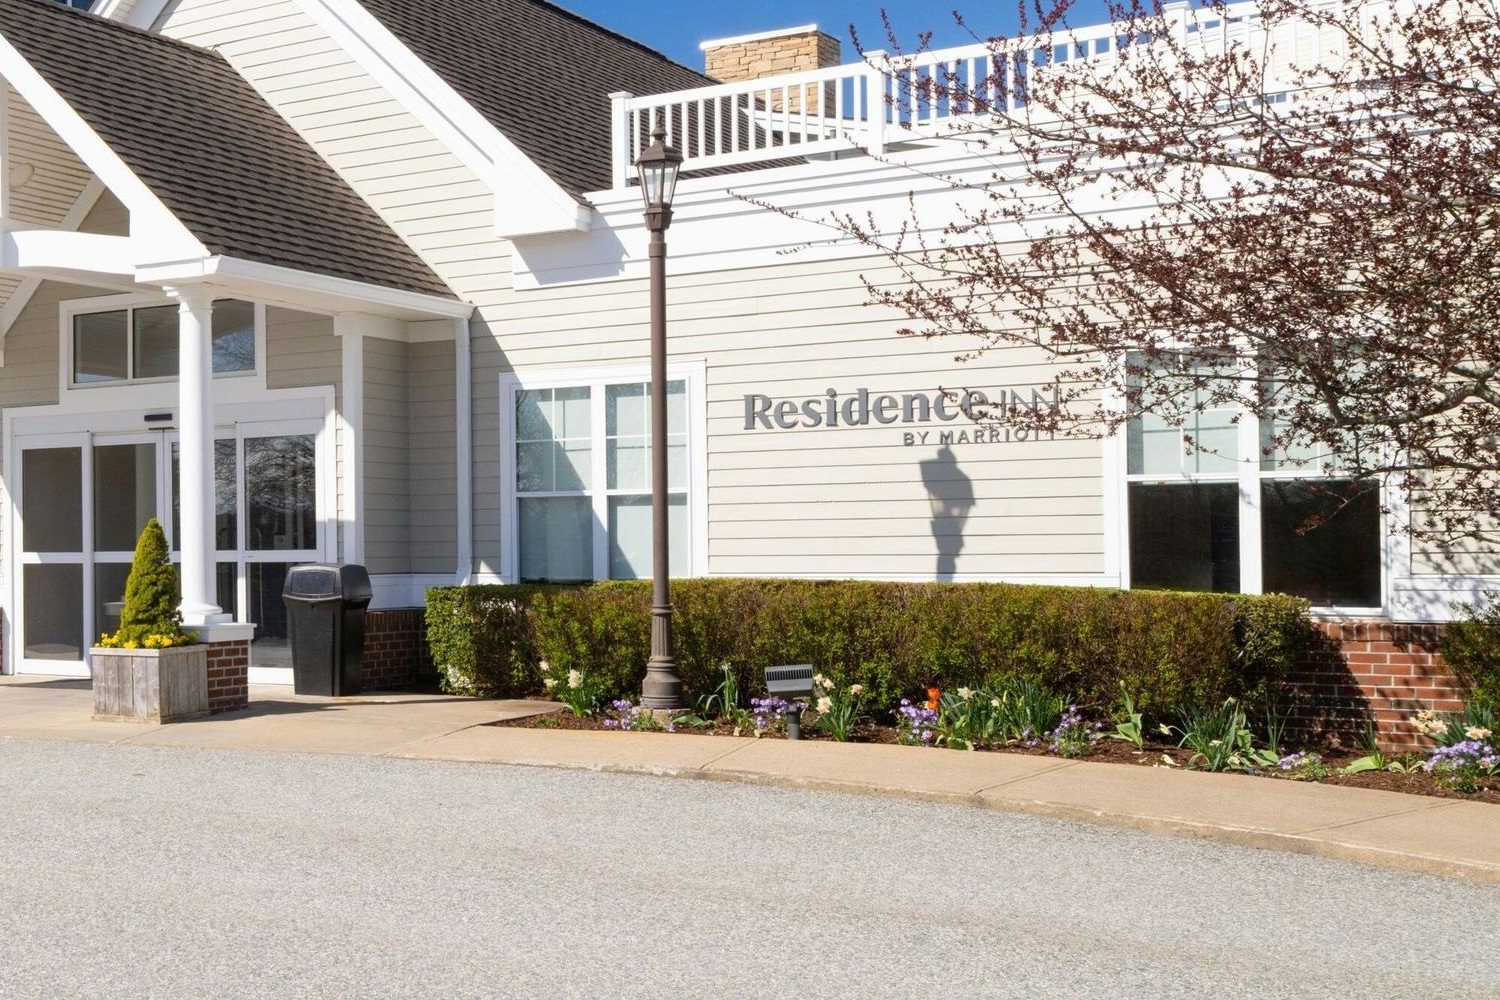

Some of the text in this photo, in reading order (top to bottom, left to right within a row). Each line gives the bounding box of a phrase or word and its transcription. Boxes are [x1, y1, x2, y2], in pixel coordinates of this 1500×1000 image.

[743, 384, 1060, 430] Residence INN
[903, 431, 930, 446] BY
